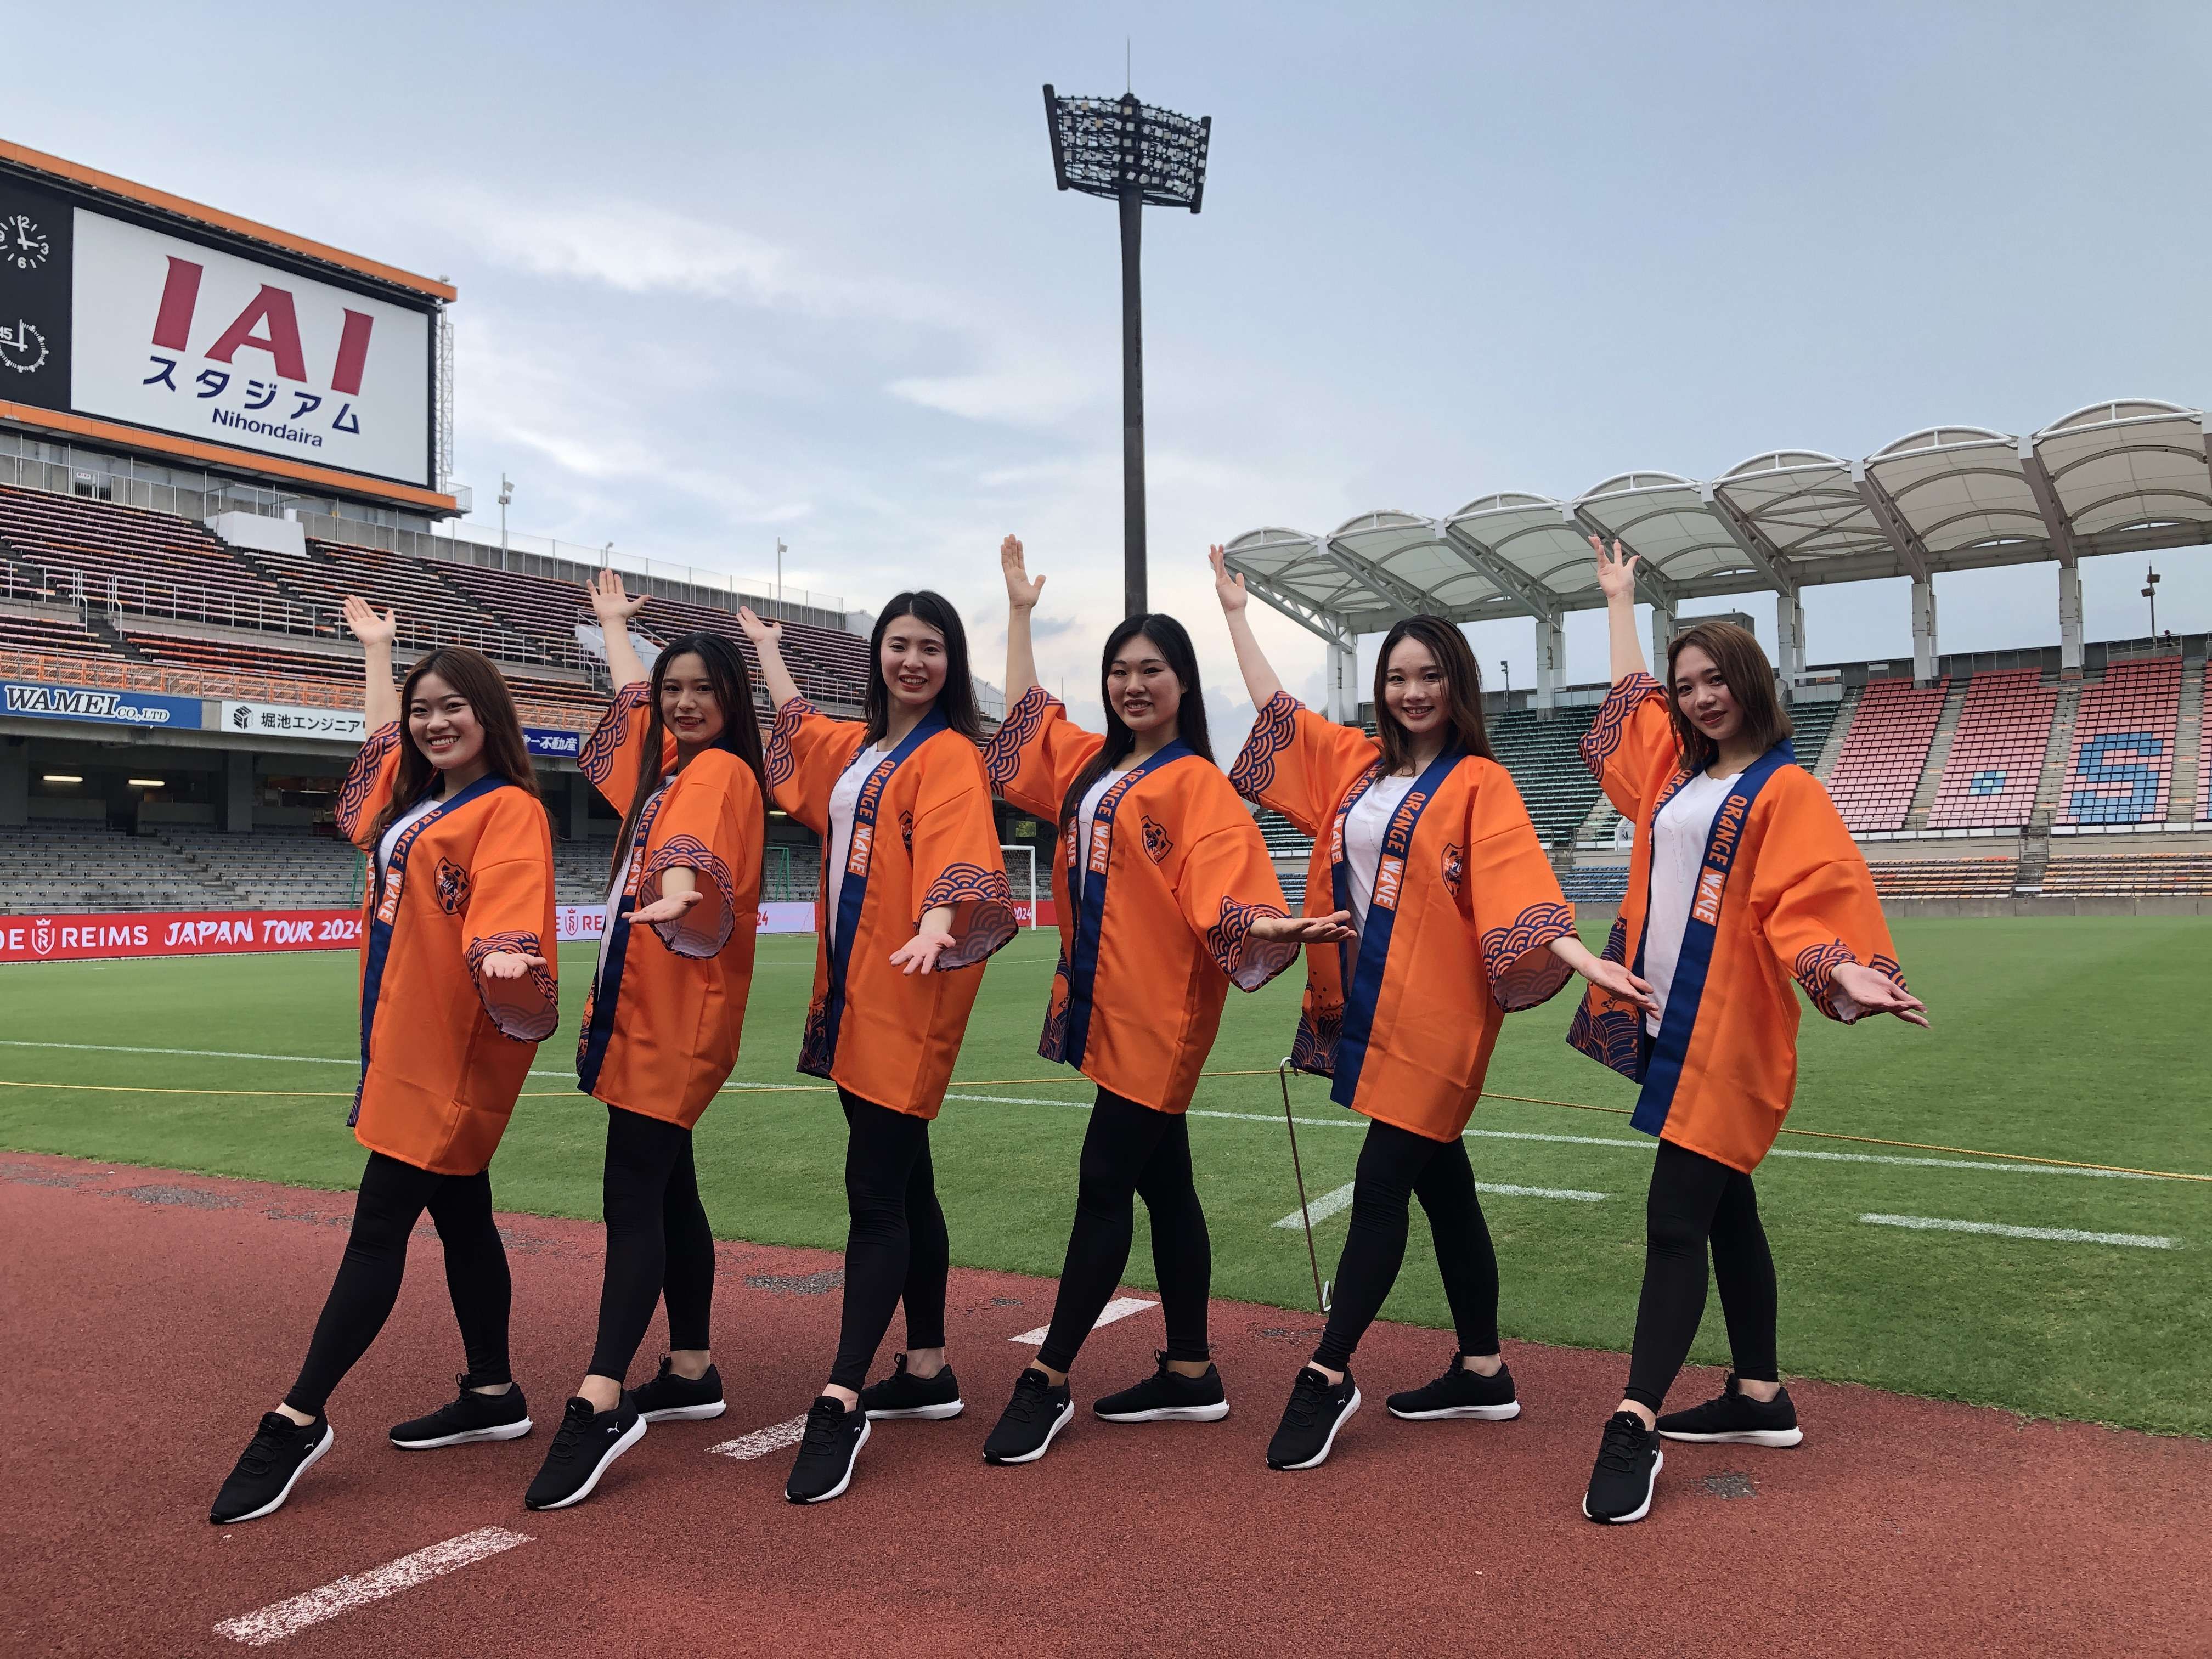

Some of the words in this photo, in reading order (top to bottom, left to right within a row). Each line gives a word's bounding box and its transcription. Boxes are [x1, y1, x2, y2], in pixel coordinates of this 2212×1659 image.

[17, 257, 27, 269] 6
[40, 242, 49, 255] 3
[151, 255, 374, 397] IAI
[143, 356, 360, 435] スタジアム
[212, 408, 323, 447] Nihondaira
[859, 760, 896, 819] ORANGE
[1098, 769, 1146, 817] ORANGE
[392, 810, 443, 865] ORANGE
[1331, 815, 1345, 862] WAVE
[1387, 792, 1426, 853] ORANGE
[1708, 795, 1748, 866] ORANGE
[624, 849, 642, 894] WAVE
[851, 827, 872, 874] WAVE
[1092, 825, 1109, 871] WAVE
[380, 873, 402, 922] WAVE
[1376, 860, 1402, 907] WAVE
[1696, 873, 1723, 923] WAVE
[61, 925, 148, 948] REIMS
[165, 917, 254, 946] JAPAN
[263, 919, 314, 944] TOUR
